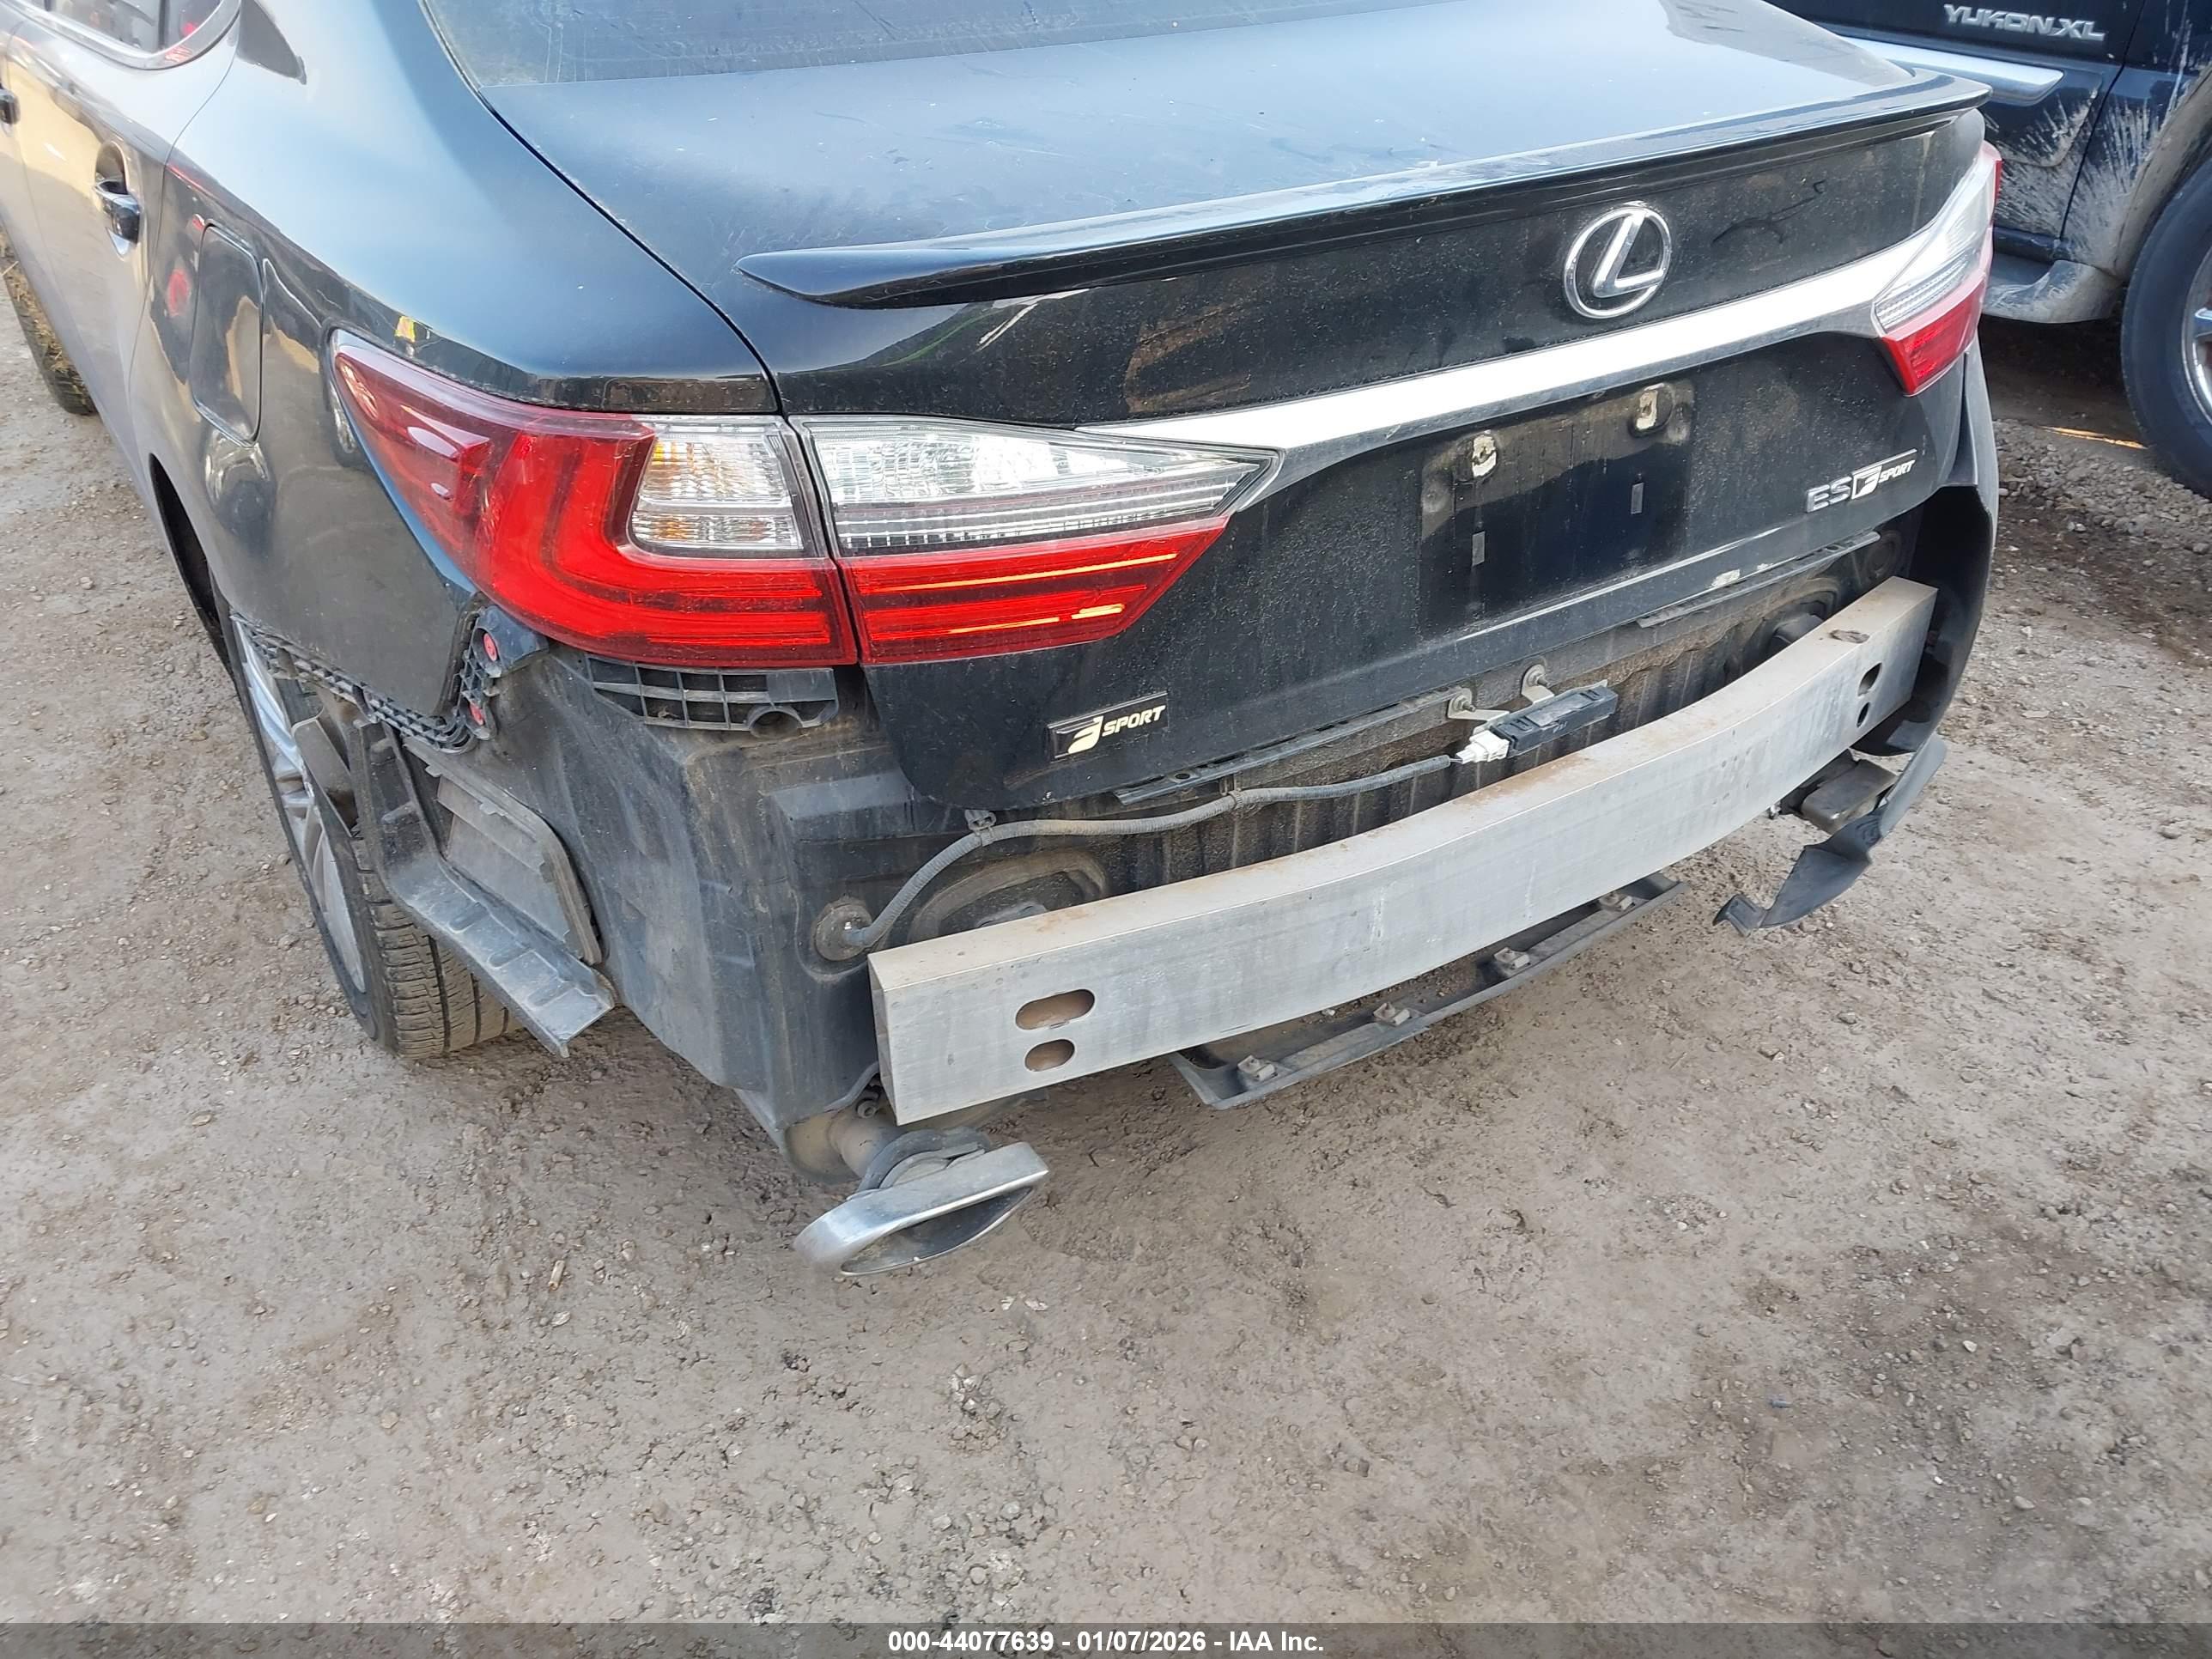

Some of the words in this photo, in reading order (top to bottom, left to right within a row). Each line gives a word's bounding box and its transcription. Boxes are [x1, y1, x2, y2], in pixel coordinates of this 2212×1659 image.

[1944, 3, 2055, 35] YUKON
[2051, 19, 2106, 41] XL
[1807, 476, 1852, 514] ES
[1878, 459, 1916, 483] SPORT
[1102, 705, 1166, 737] SPORT
